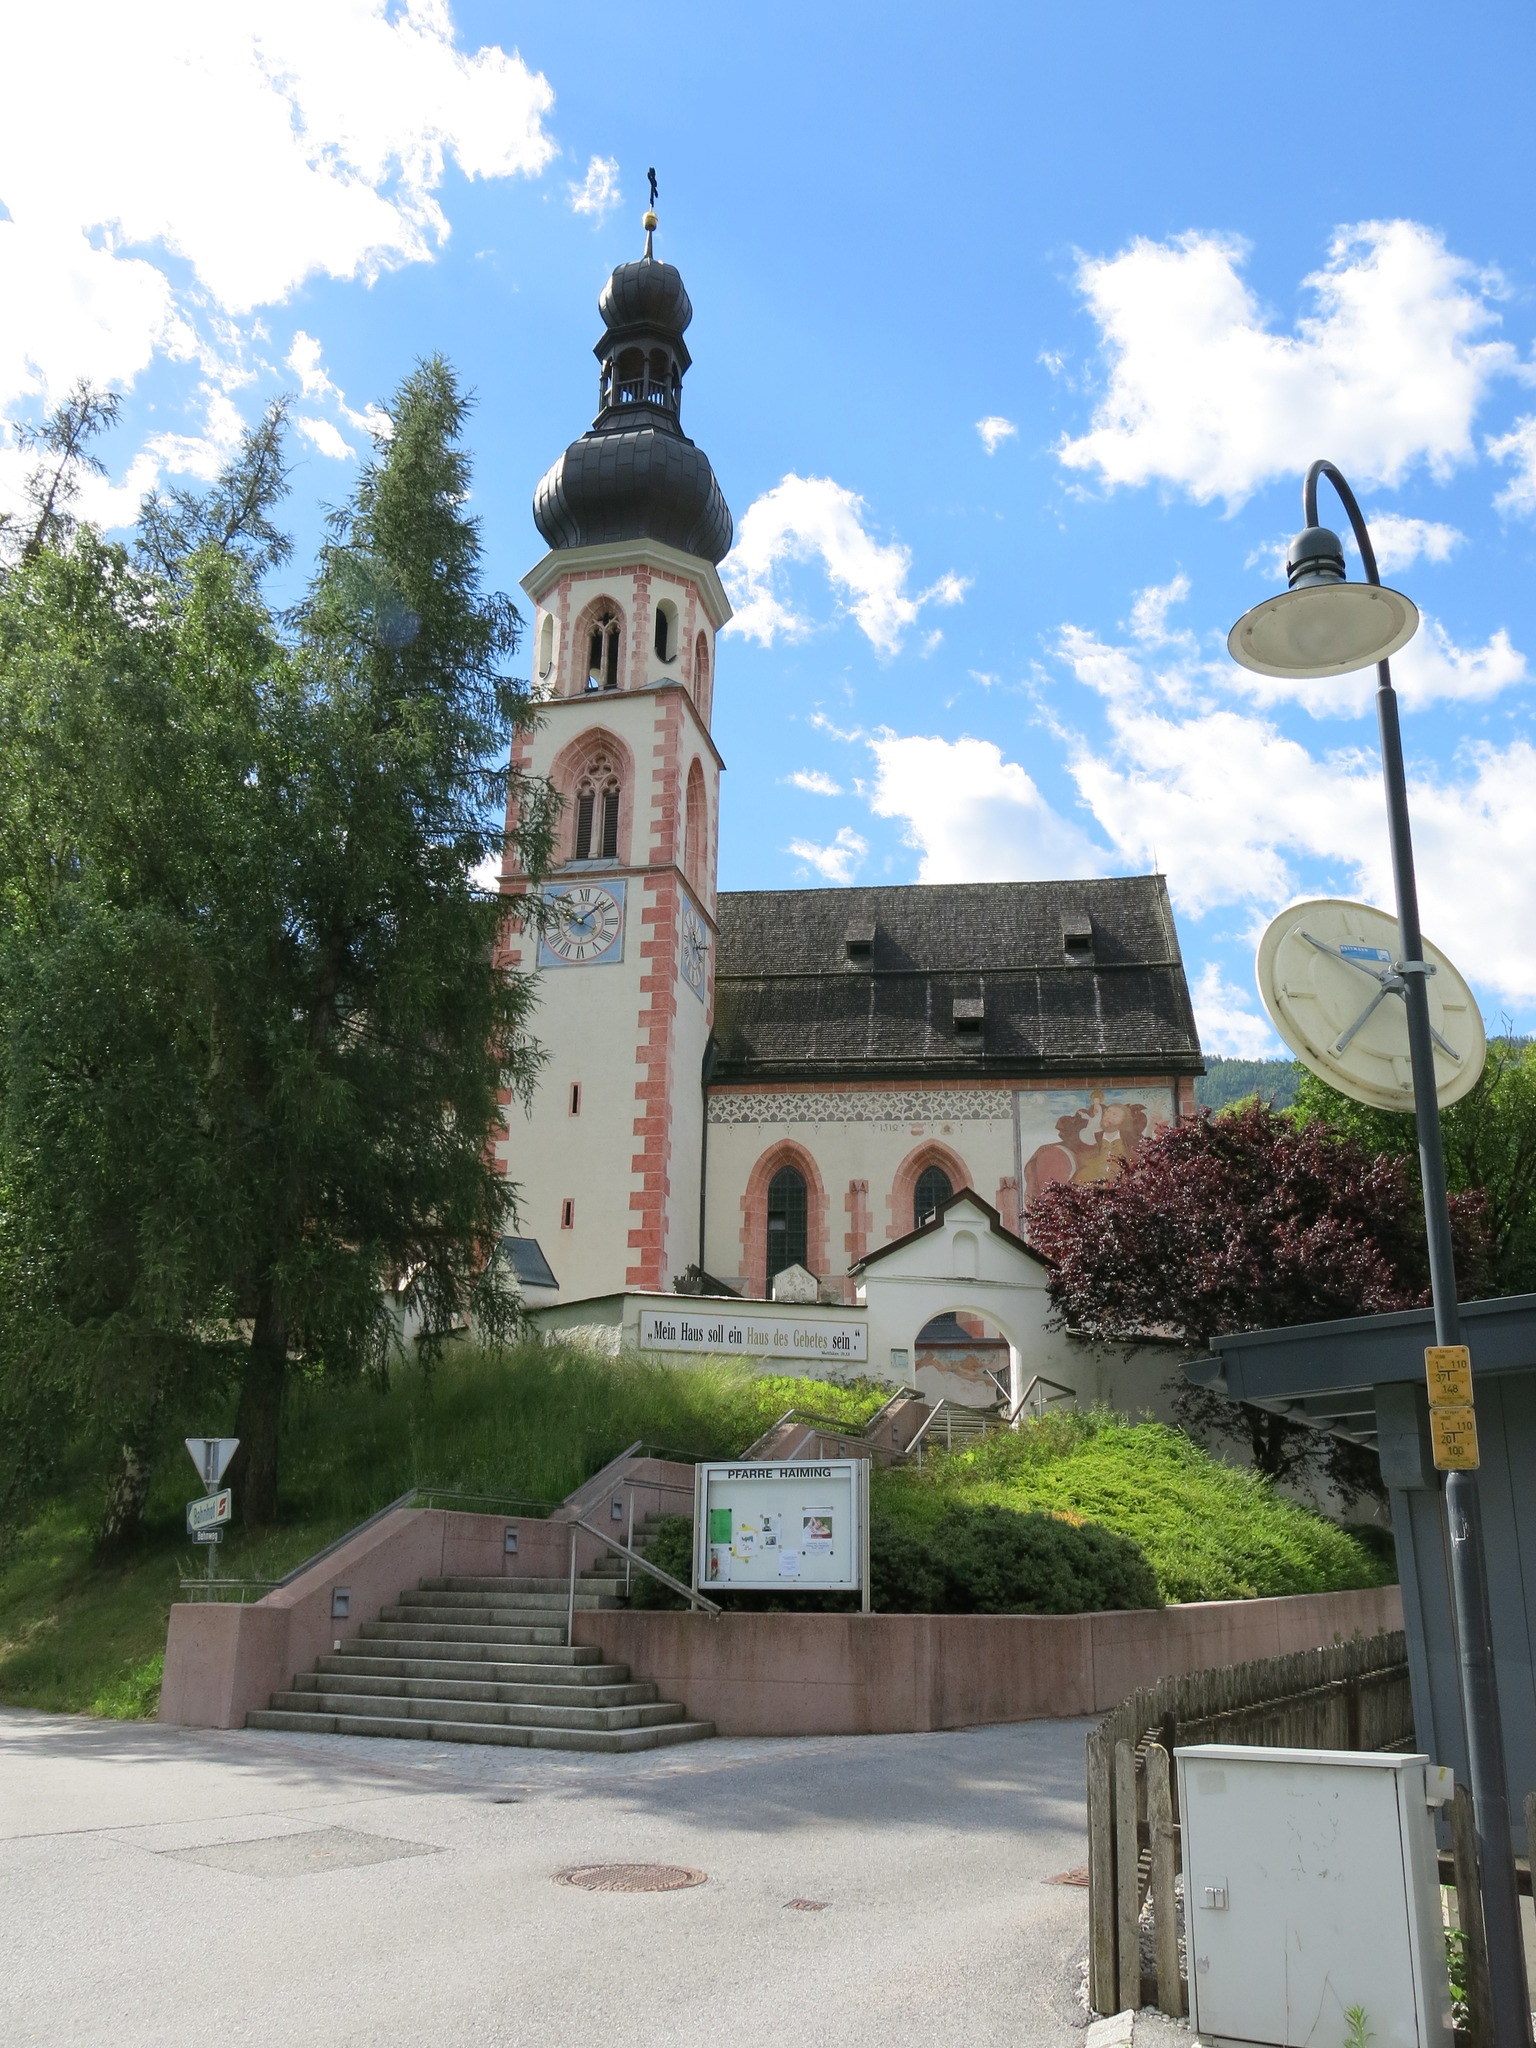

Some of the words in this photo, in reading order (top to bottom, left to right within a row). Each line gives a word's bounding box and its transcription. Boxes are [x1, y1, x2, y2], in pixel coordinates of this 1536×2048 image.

[681, 1322, 704, 1342] Haus
[708, 1324, 724, 1343] soll
[728, 1326, 742, 1344] ein
[747, 1327, 769, 1346] Haus
[773, 1328, 789, 1347] des
[793, 1329, 828, 1350] Gebetes
[1451, 1360, 1467, 1369] 110
[1456, 1421, 1473, 1431] 110
[728, 1468, 773, 1479] PFARRE
[780, 1467, 831, 1478] HAIMING
[194, 1501, 216, 1525] Bahnhof
